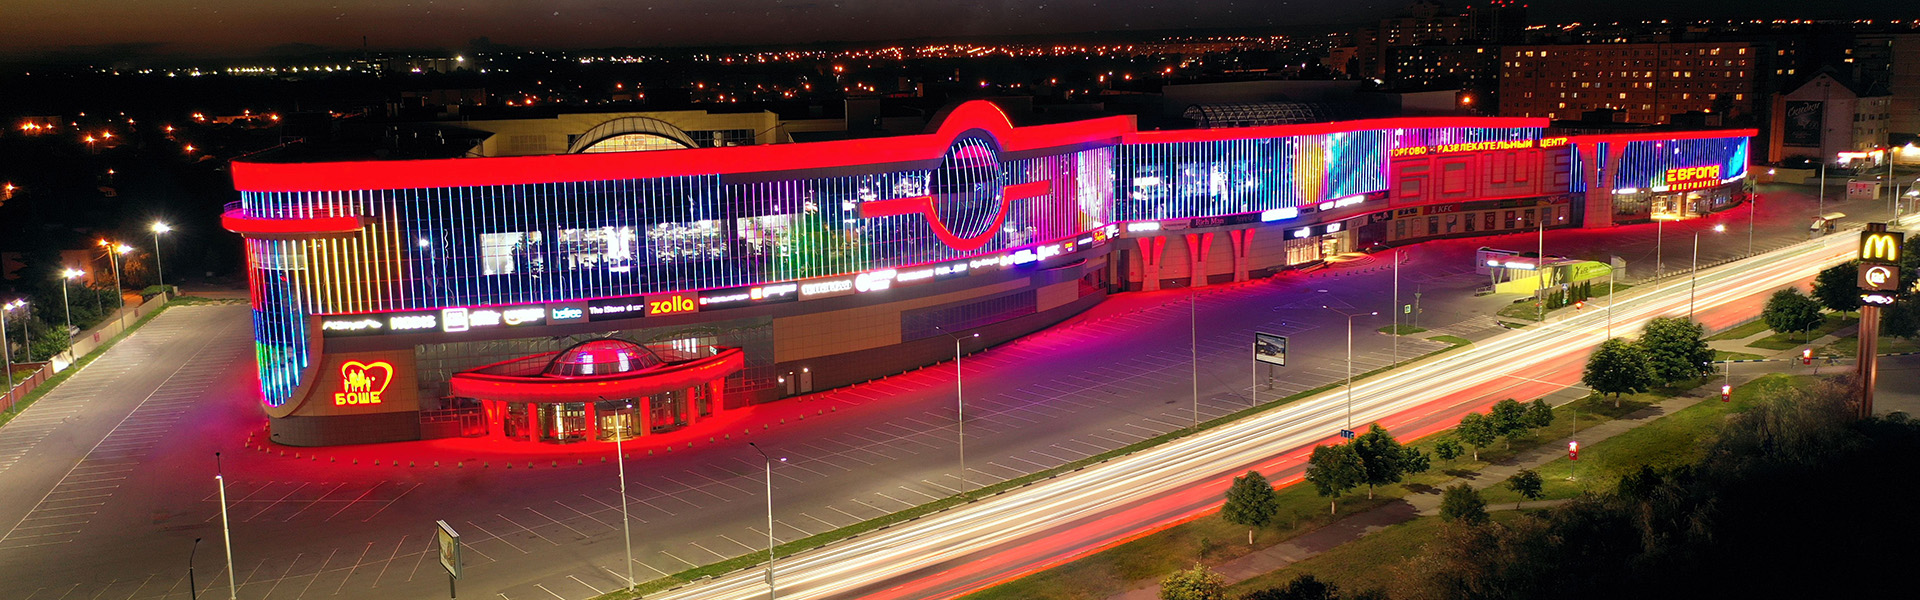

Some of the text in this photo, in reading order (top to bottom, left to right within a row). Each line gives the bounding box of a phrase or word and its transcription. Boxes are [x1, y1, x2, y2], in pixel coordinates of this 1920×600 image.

[1788, 102, 1820, 117] Скидки
[1390, 146, 1427, 157] ТОРГОВО
[1437, 140, 1532, 153] РАЗВЛЕКАТЕЛЬНЫЙ
[1540, 137, 1568, 148] ЦЕНТР
[1437, 204, 1453, 213] KFC
[1195, 216, 1224, 226] Rich Man
[650, 295, 694, 314] zolla
[552, 307, 583, 320] befree
[335, 391, 382, 406] БОШЕ
